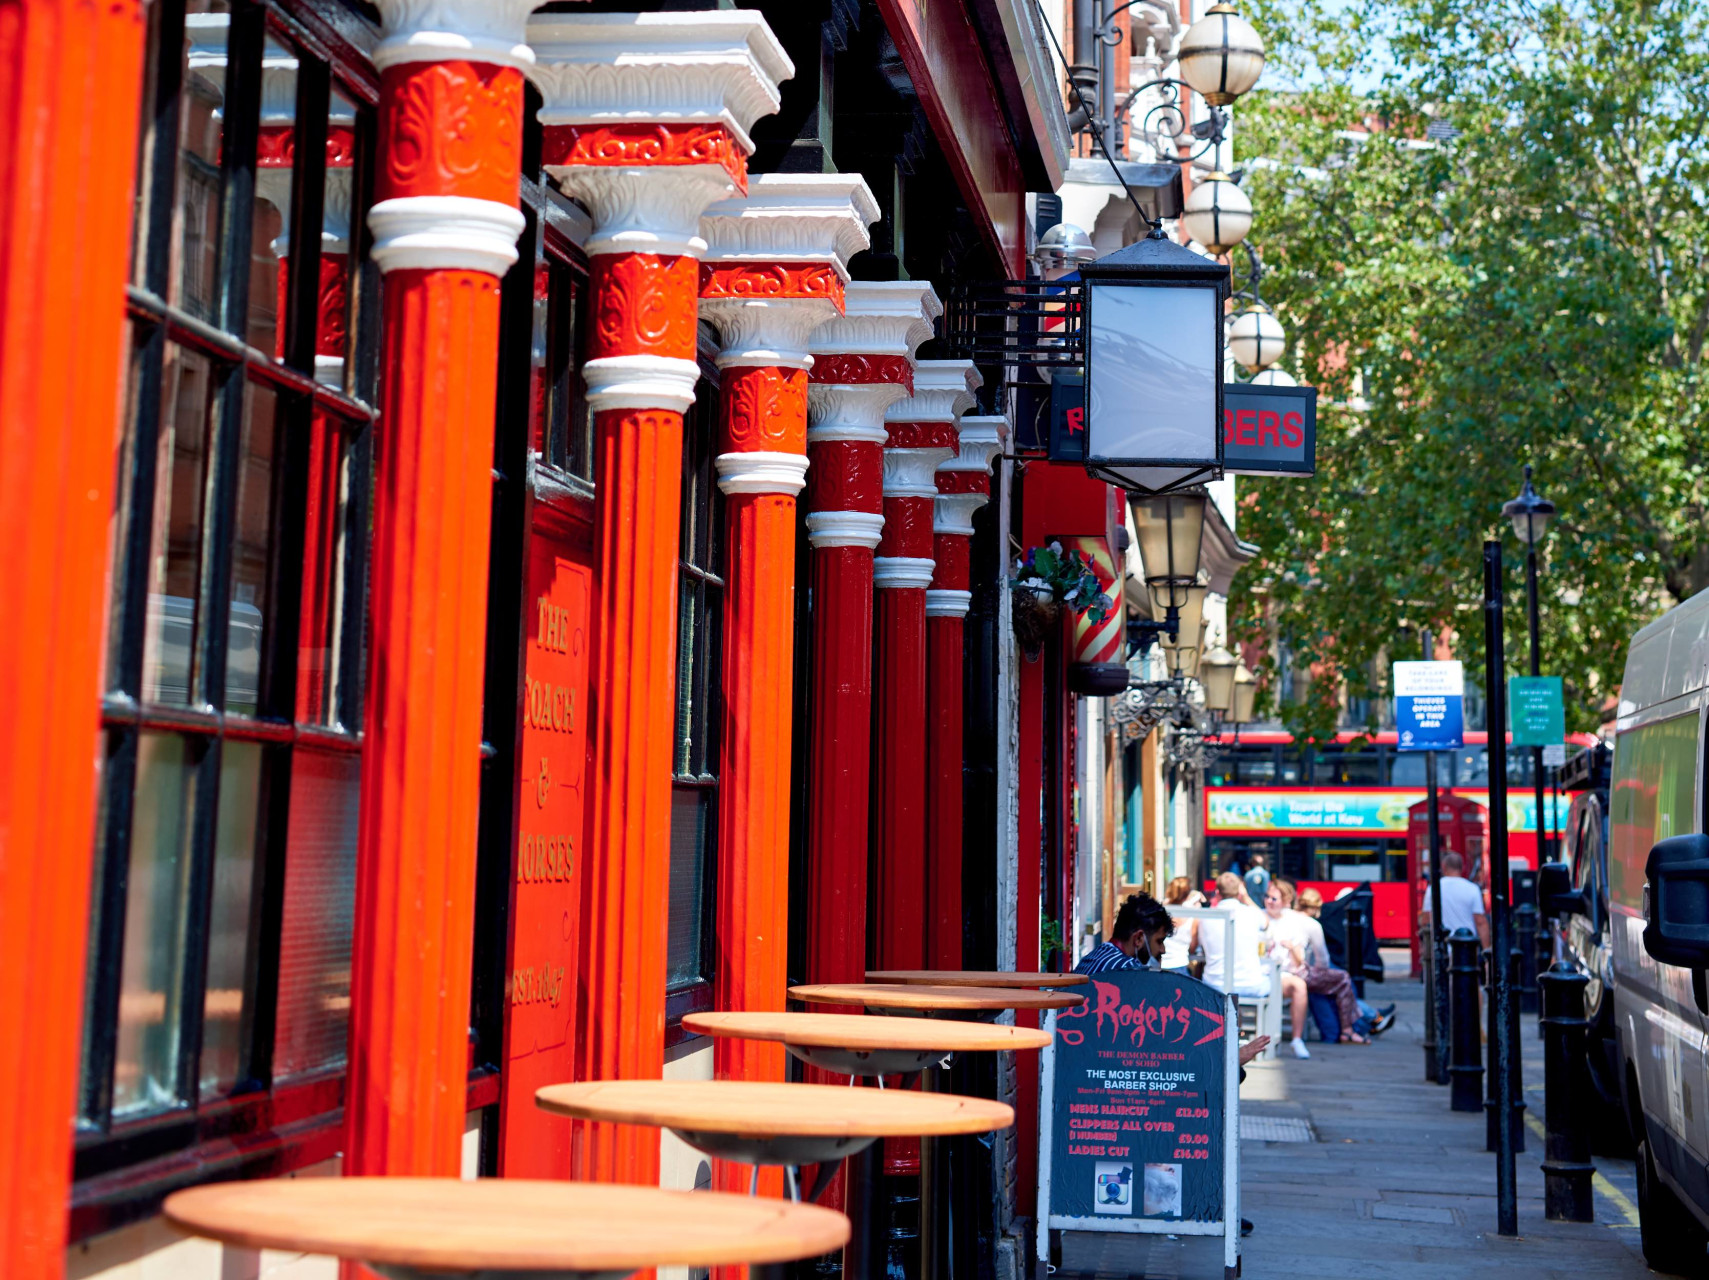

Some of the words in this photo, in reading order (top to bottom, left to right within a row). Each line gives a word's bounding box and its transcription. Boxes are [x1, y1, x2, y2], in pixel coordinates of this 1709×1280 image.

[537, 596, 569, 651] THE
[1413, 697, 1446, 705] THIEVES
[1412, 705, 1447, 713] OPERATE
[1420, 720, 1440, 728] AREA
[537, 757, 550, 807] &
[1091, 979, 1191, 1048] Roger's
[1117, 1051, 1149, 1060] DEMON
[1150, 1052, 1185, 1060] BARBER
[1135, 1060, 1160, 1068] SOHO
[1086, 1069, 1106, 1079] THE
[1108, 1070, 1137, 1080] MOST
[1140, 1071, 1195, 1082] EXCLUSIVE
[1104, 1080, 1146, 1090] BARBER
[1149, 1081, 1177, 1091] SHOP
[1069, 1104, 1098, 1114] MENS
[1101, 1105, 1149, 1116] HAIRCUT
[1175, 1108, 1209, 1118] £12.00
[1069, 1118, 1120, 1130] CLIPPERS
[1121, 1121, 1141, 1131] ALL
[1143, 1121, 1175, 1132] OVER
[1077, 1131, 1117, 1142] NUMBER)
[1178, 1134, 1209, 1144] £9.00
[1068, 1145, 1105, 1156] LADIES
[1108, 1146, 1130, 1157] CUT
[1173, 1149, 1209, 1159] £16.00
